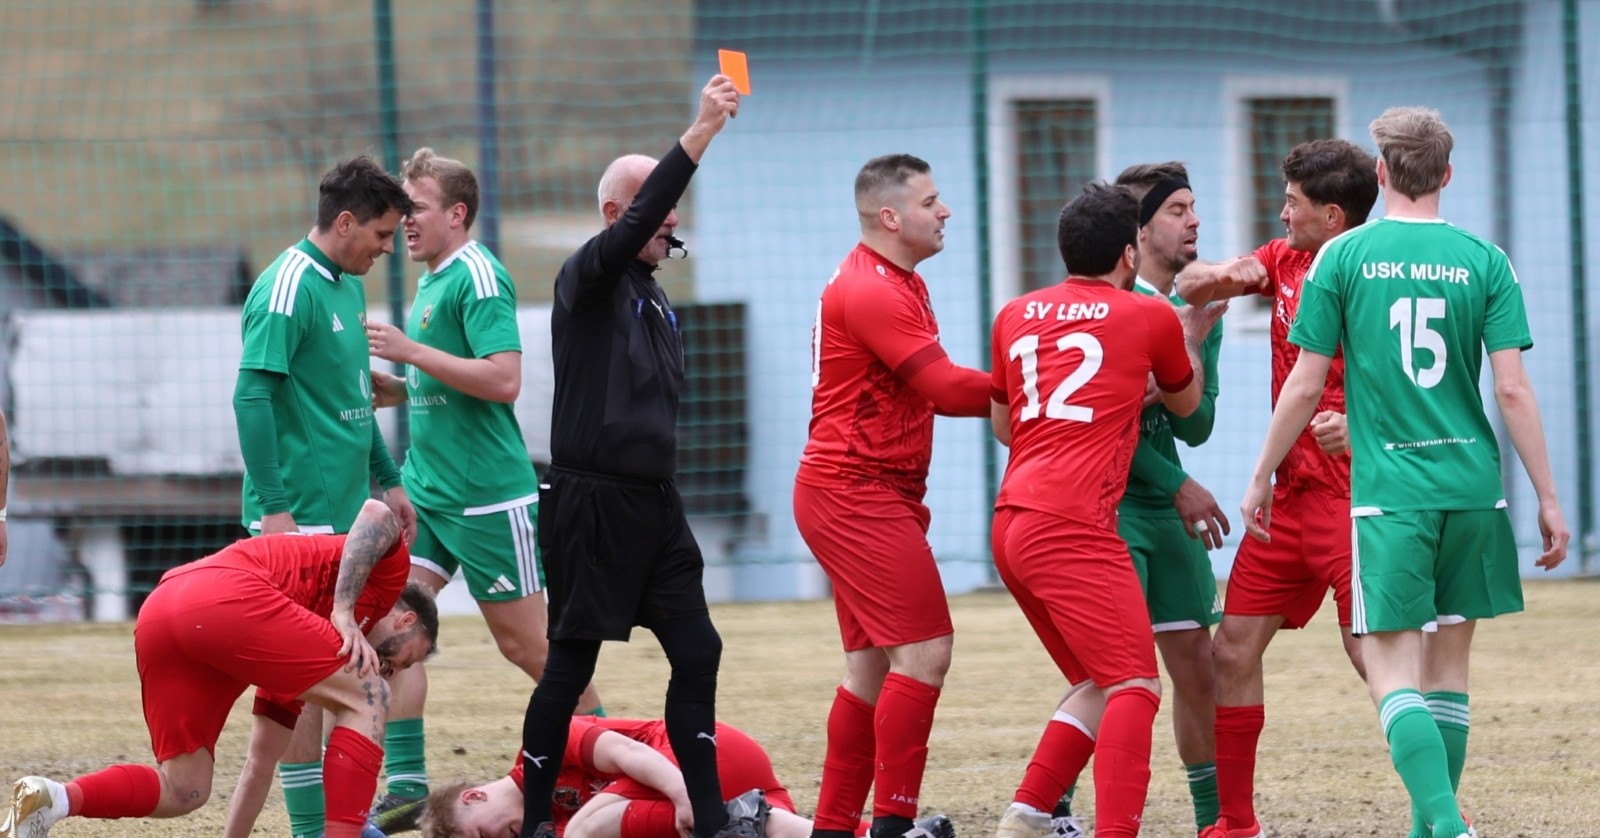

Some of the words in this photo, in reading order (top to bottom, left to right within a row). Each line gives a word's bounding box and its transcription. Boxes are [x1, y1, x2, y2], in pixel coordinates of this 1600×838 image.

[1362, 262, 1405, 279] USK
[1411, 263, 1470, 286] MUHR
[1023, 301, 1054, 320] SV
[1389, 297, 1447, 389] 15
[1008, 331, 1104, 423] 12
